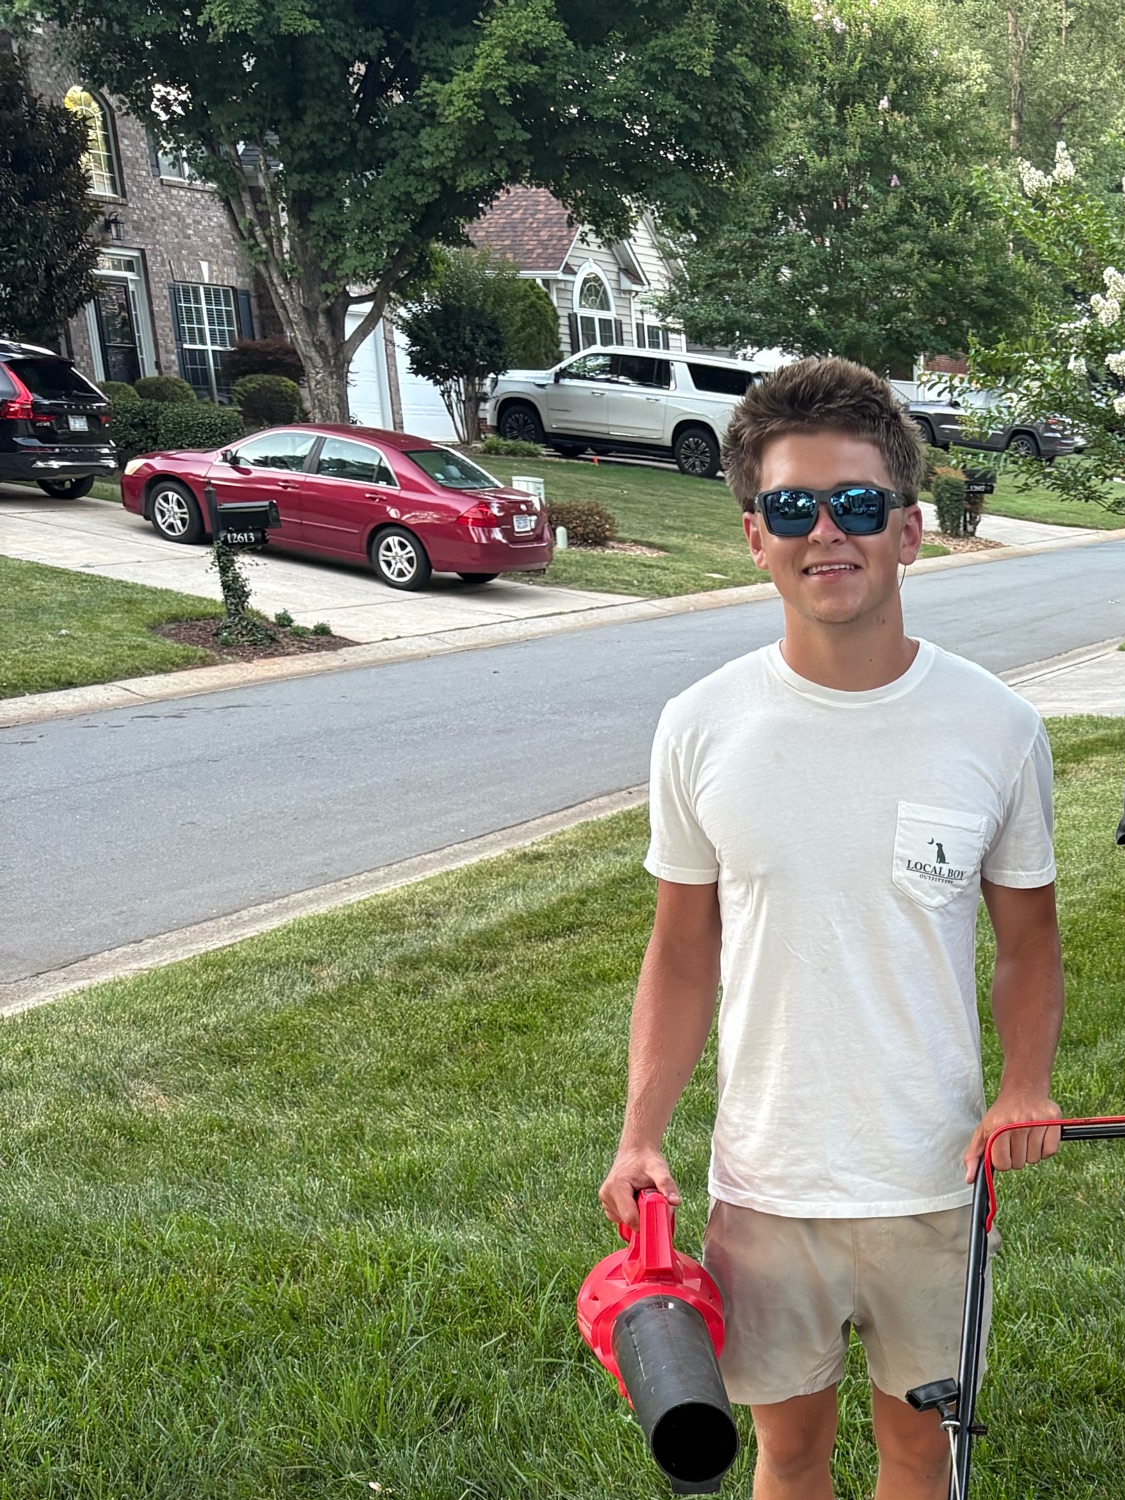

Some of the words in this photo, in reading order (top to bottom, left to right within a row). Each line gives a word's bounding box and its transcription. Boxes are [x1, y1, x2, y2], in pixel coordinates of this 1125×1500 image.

[227, 532, 255, 544] 12613
[907, 860, 945, 877] LOCAL
[947, 868, 967, 880] BOY
